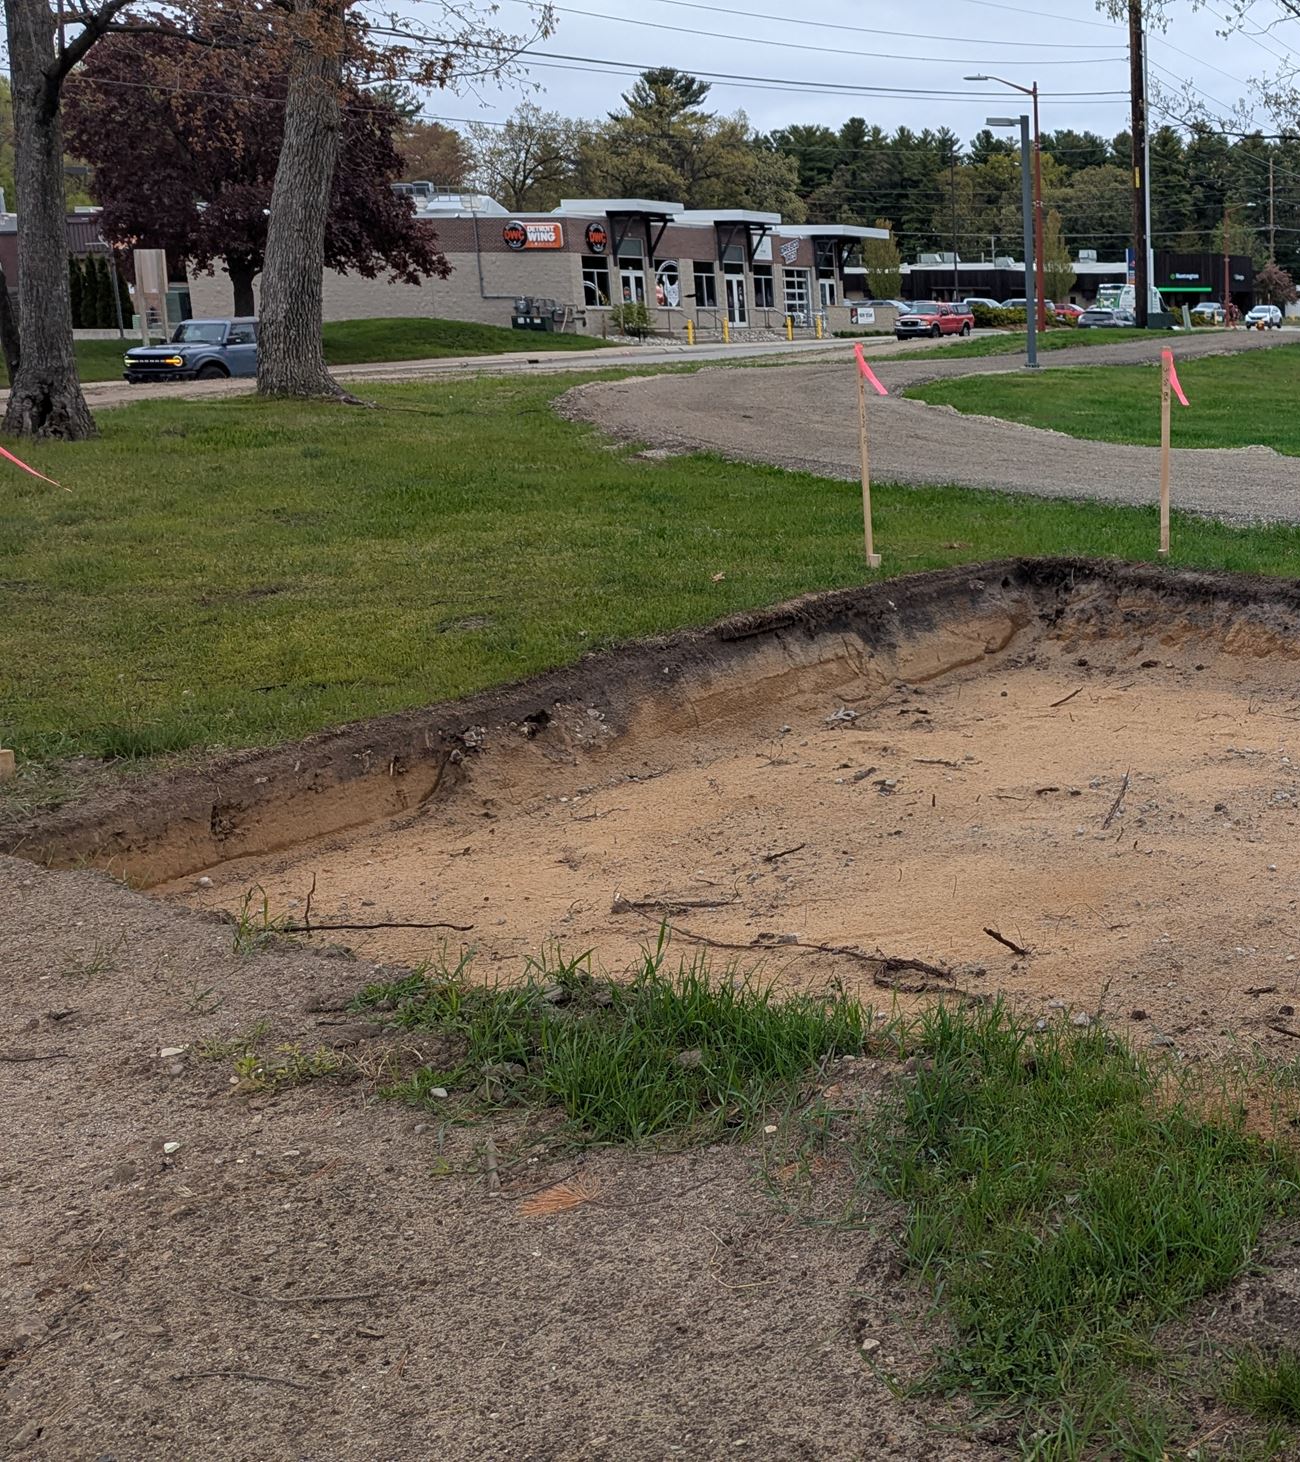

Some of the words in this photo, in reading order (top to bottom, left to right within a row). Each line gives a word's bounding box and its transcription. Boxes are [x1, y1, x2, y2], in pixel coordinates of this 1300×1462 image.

[504, 230, 525, 240] DWC
[527, 232, 556, 242] WING
[588, 231, 608, 243] DWC
